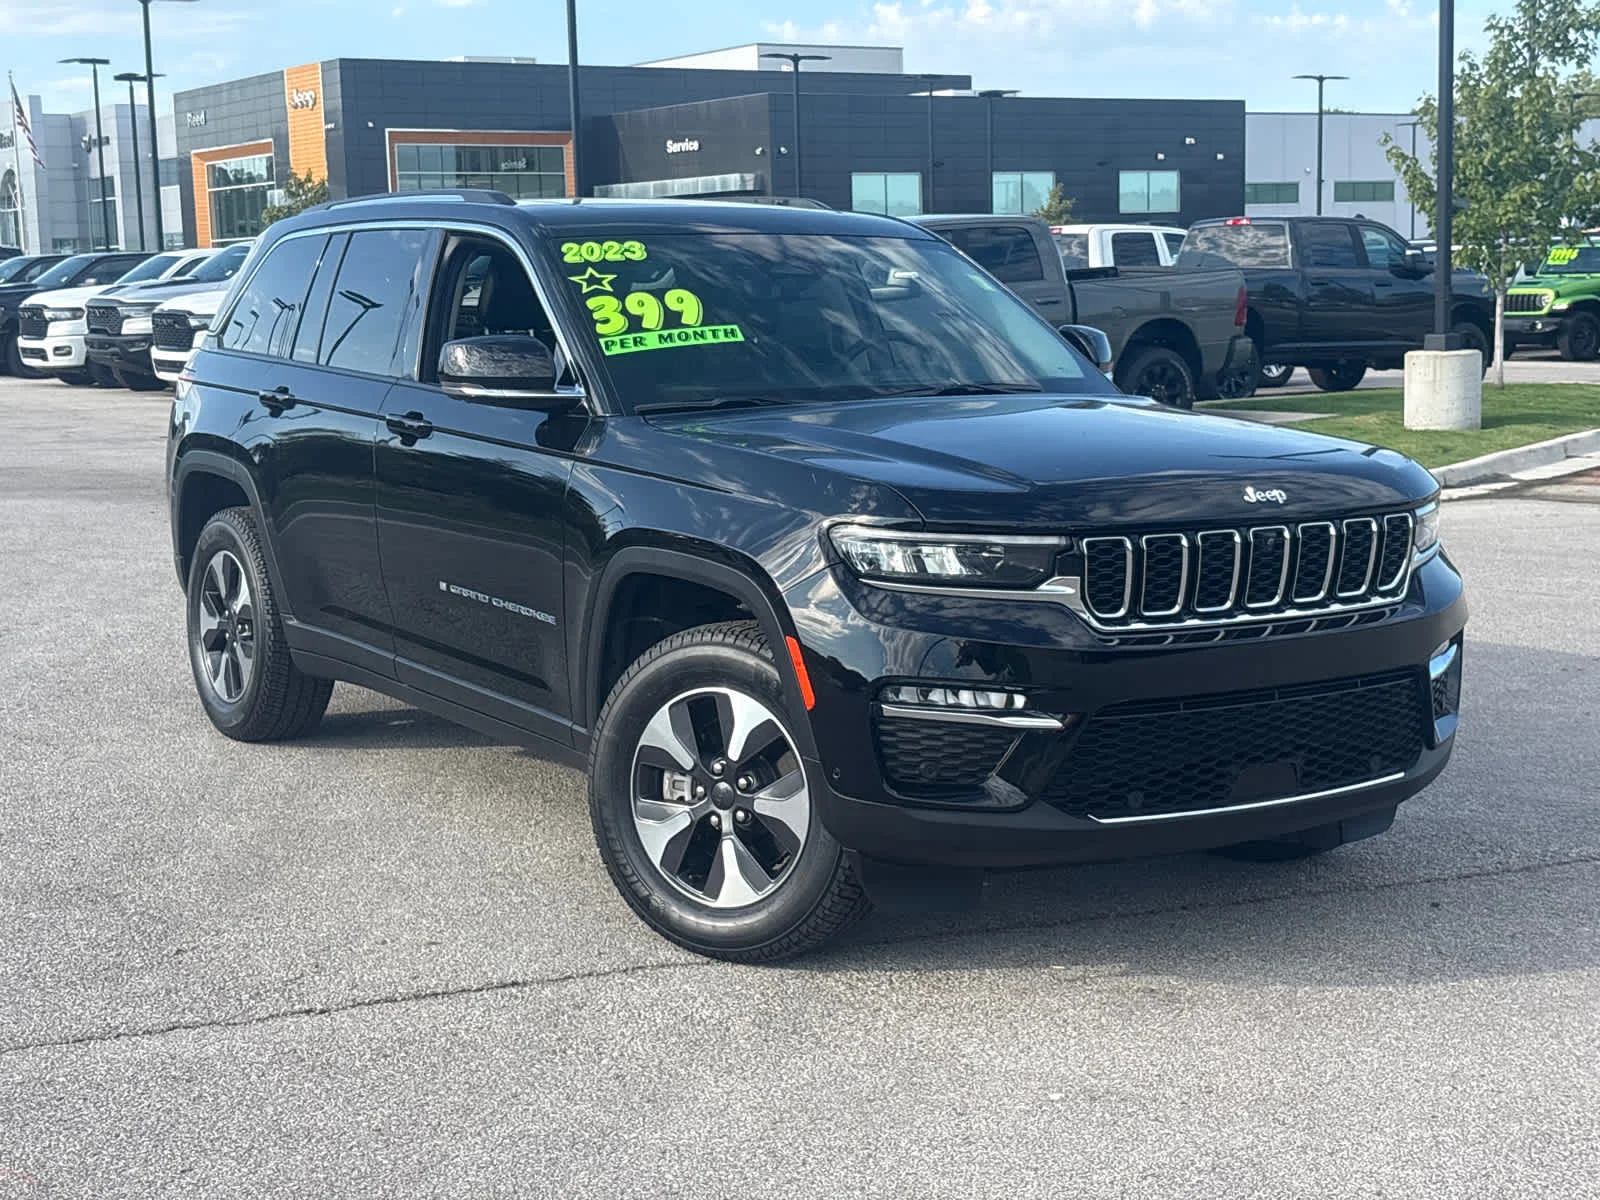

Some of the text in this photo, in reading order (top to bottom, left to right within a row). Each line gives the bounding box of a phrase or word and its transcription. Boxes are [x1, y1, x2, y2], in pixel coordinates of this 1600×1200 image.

[290, 88, 316, 110] Jeep
[186, 110, 206, 128] Reed
[666, 137, 700, 154] Service
[561, 241, 648, 263] 2023
[586, 289, 704, 336] 399
[604, 328, 738, 352] PER MONTH
[1243, 486, 1287, 504] Jeep
[449, 583, 557, 626] GRAND CHEROKEE
